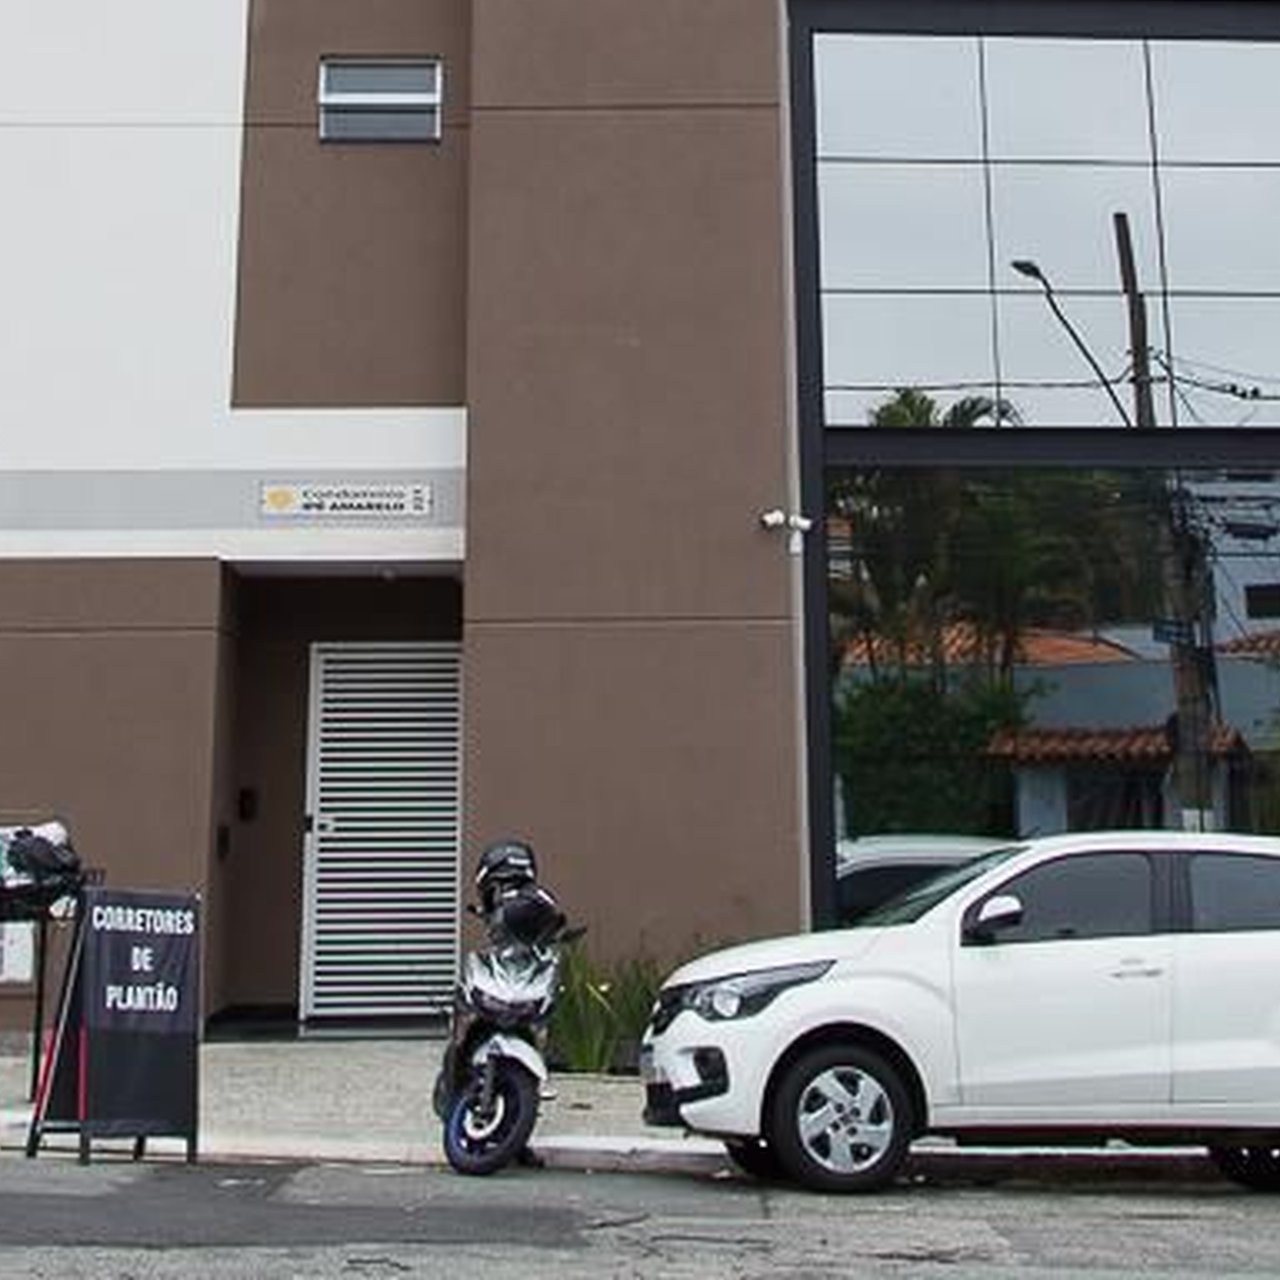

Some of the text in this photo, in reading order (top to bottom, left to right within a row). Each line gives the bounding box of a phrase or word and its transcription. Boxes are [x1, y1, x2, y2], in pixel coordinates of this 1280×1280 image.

[92, 905, 194, 934] CORRETORES
[131, 946, 154, 971] DE
[105, 981, 178, 1011] PLANTÃO
